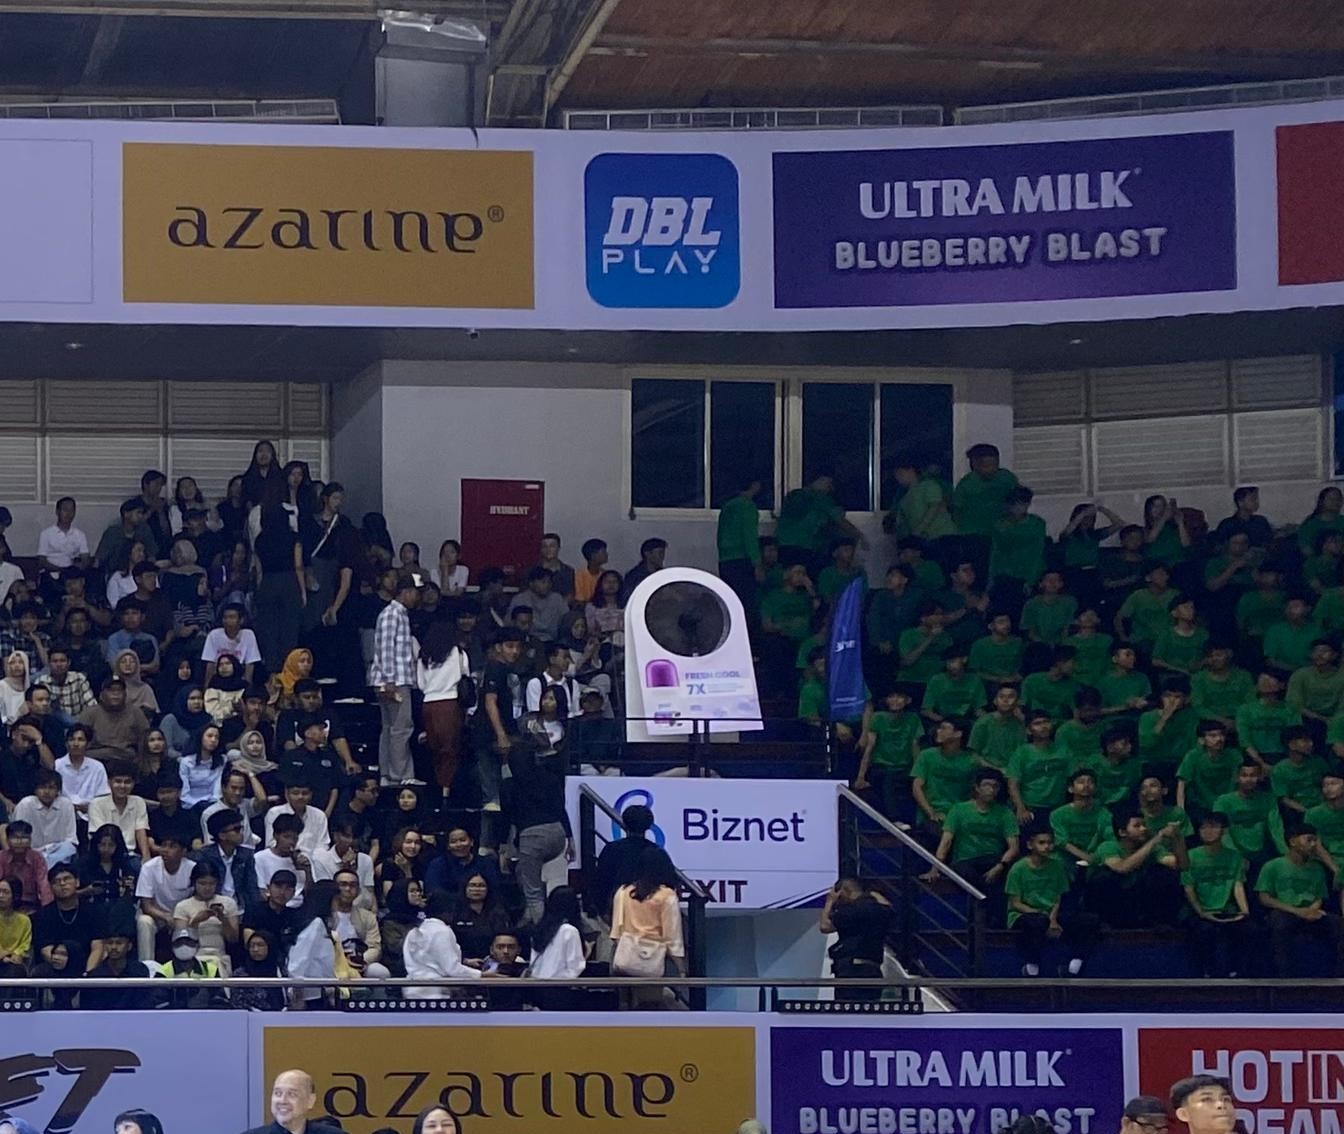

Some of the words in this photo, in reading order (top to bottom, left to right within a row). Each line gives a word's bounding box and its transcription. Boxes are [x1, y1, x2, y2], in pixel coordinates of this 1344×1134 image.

[859, 179, 1008, 219] ULTRA
[1012, 169, 1141, 216] MILK
[602, 196, 722, 246] DBL
[602, 249, 718, 275] PLAY
[835, 232, 1031, 271] BLUEBERRY
[1047, 227, 1167, 263] BLAST
[683, 808, 805, 842] Biznet
[822, 1050, 947, 1086] ULTRA
[959, 1049, 1072, 1087] MILK
[799, 1107, 975, 1134] BLUEBERRY
